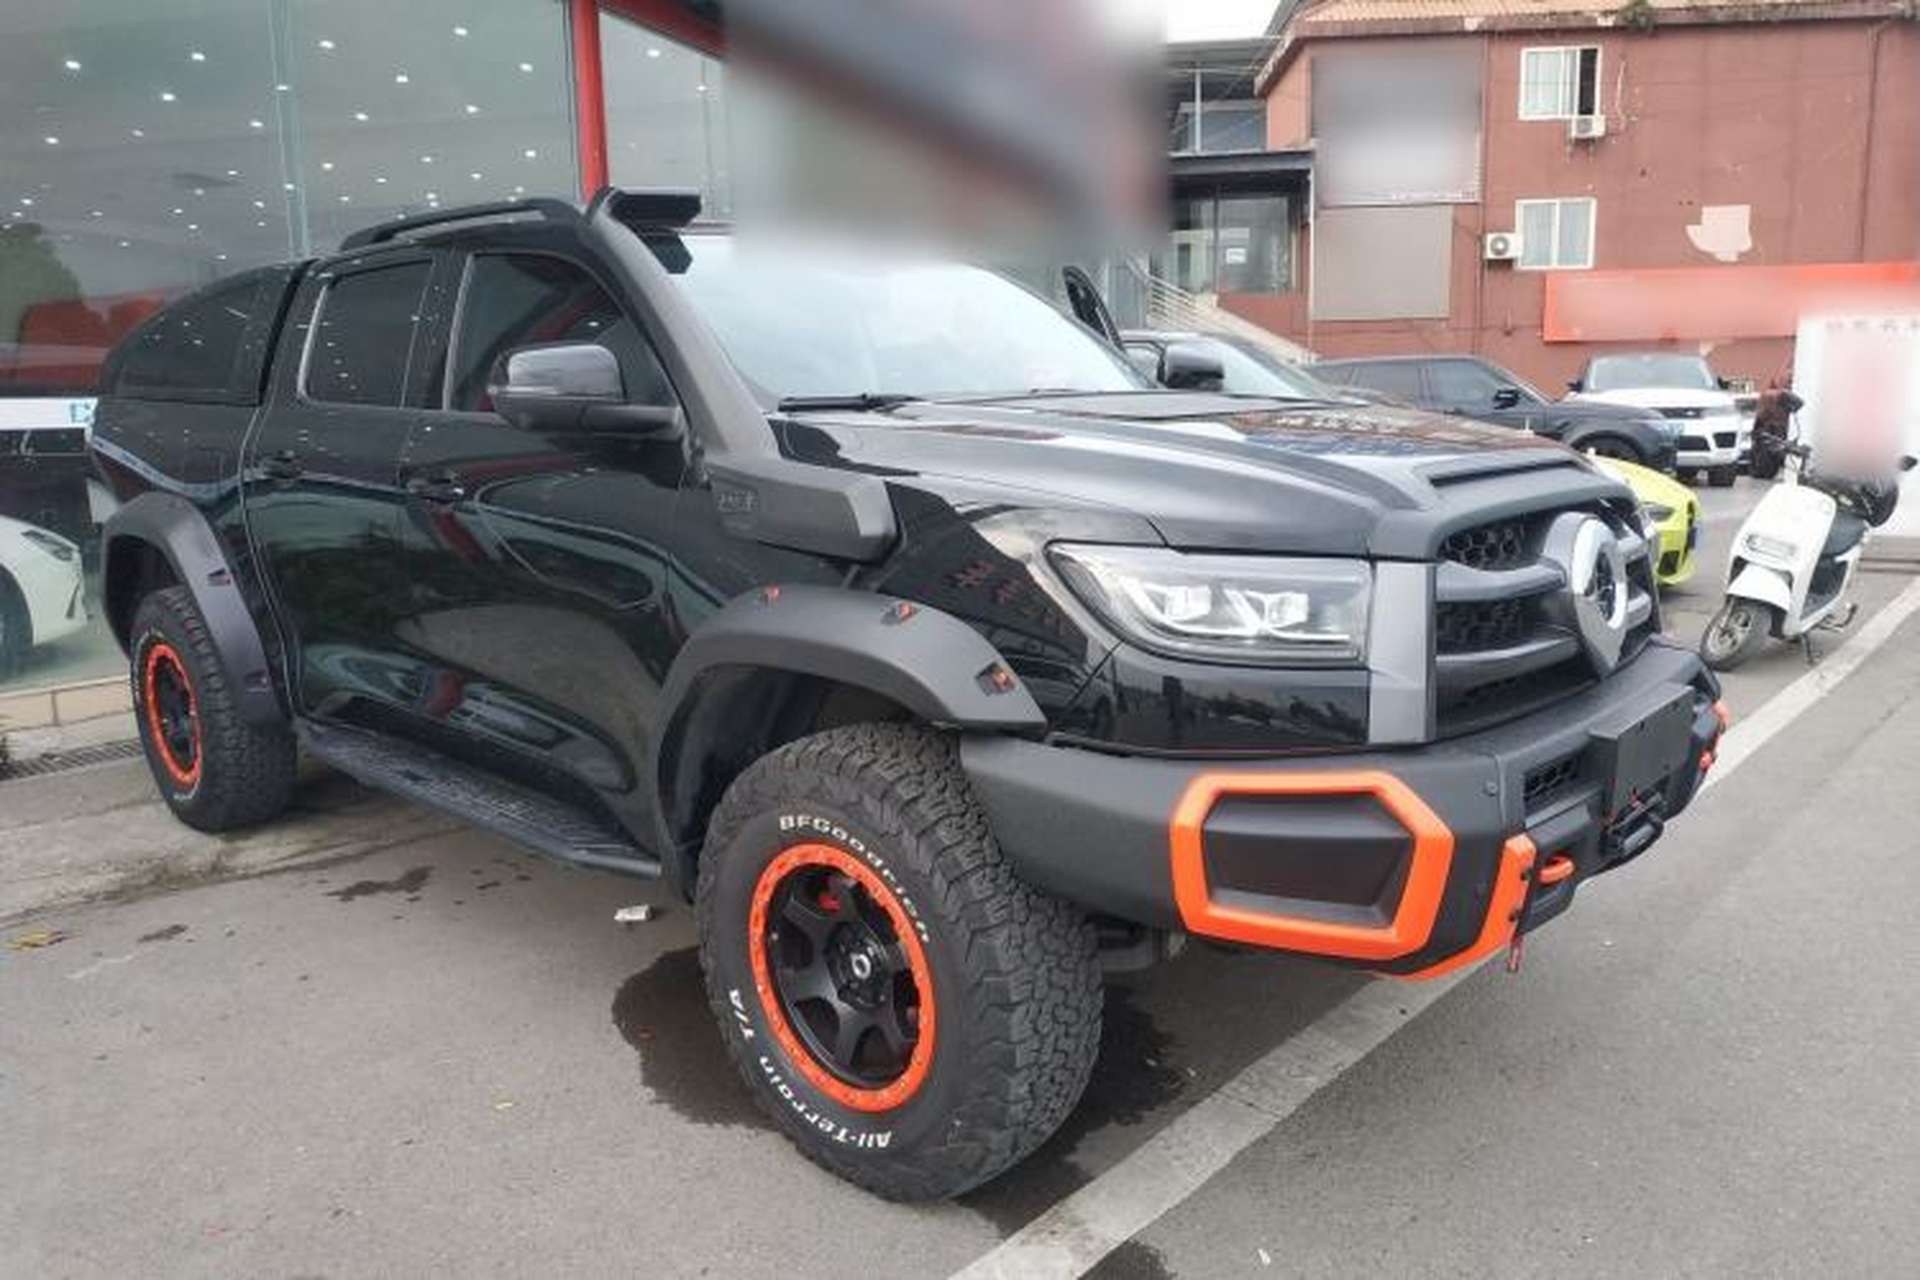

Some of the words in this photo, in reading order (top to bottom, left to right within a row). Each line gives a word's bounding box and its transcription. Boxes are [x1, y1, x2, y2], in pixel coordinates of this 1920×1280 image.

[779, 815, 931, 943] BFGoodrich
[729, 989, 754, 1040] T/A
[758, 1056, 893, 1148] All-Terrain
